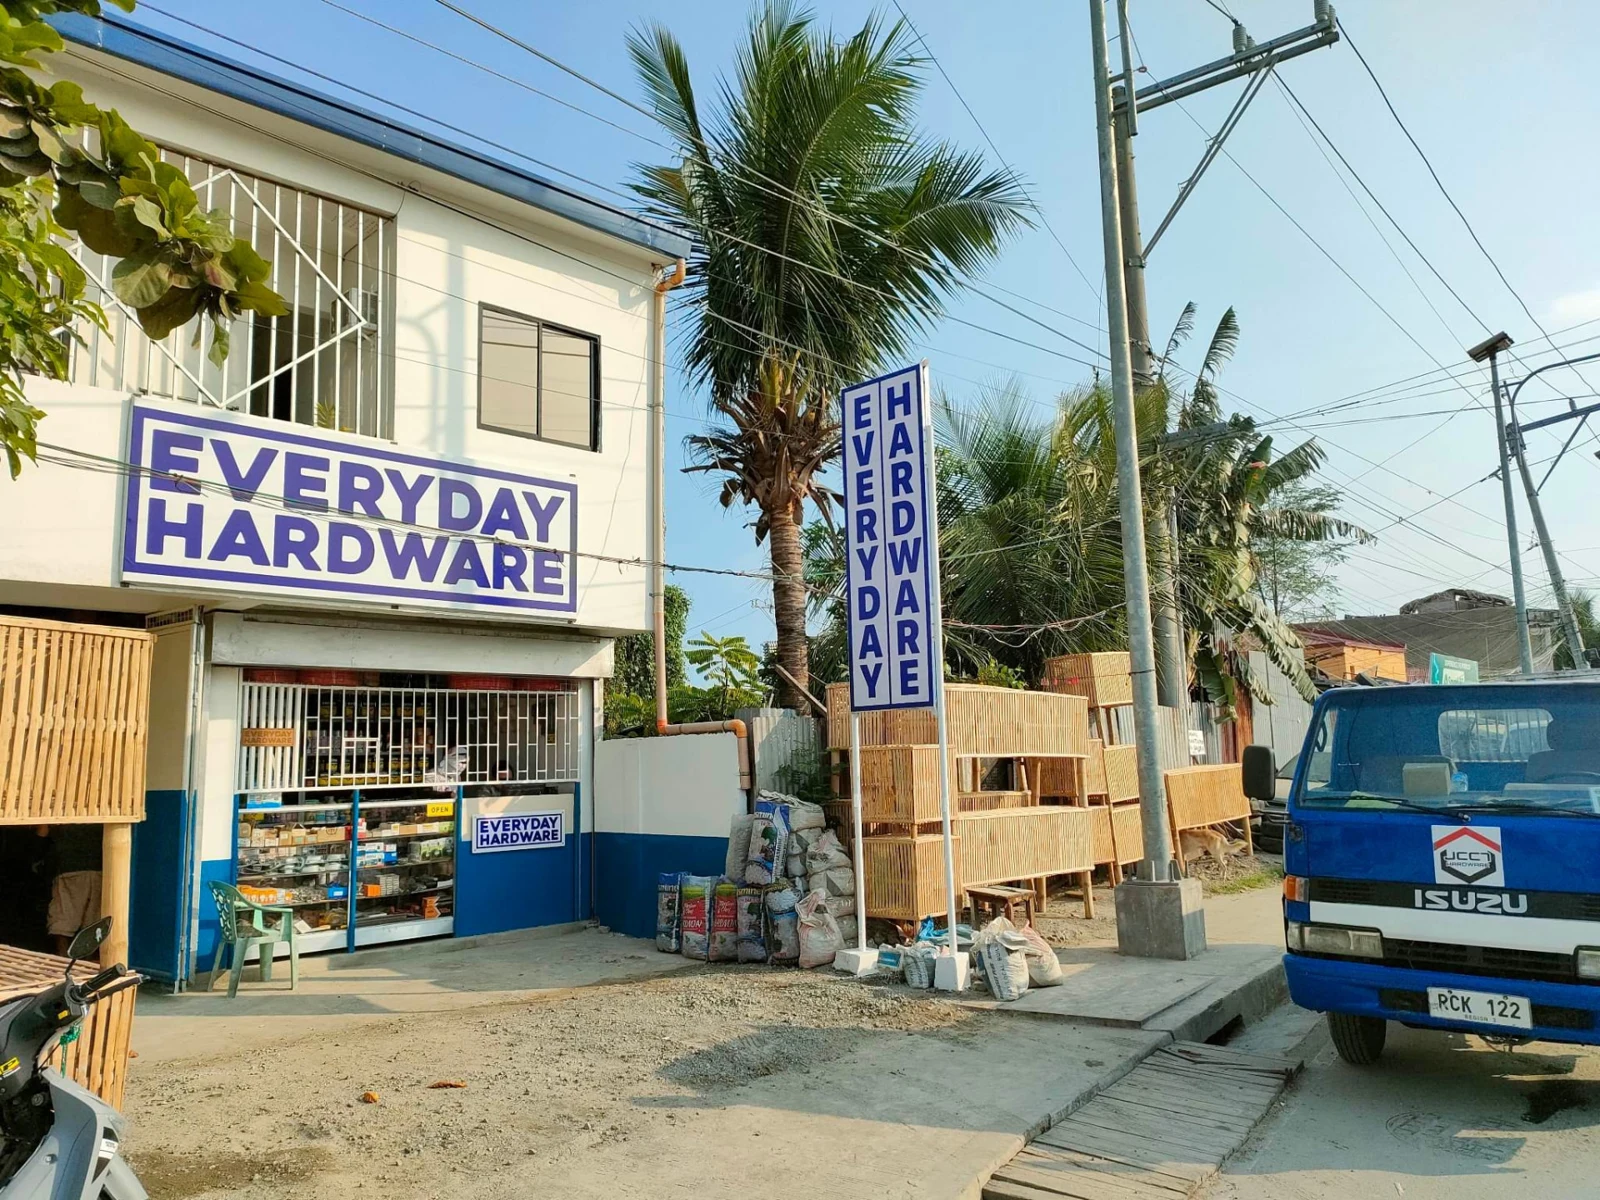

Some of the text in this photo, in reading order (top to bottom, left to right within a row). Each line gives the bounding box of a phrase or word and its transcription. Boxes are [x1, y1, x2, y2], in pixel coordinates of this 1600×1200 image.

[149, 429, 564, 543] EVERYDAY
[146, 498, 564, 596] HARDWARE
[852, 394, 883, 698] EVERYDAY
[887, 381, 921, 696] HARDWARE
[244, 730, 292, 738] EVERYDAY
[431, 806, 449, 814] OPEN
[480, 816, 558, 833] EVERYDAY
[480, 829, 559, 846] HARDWARE
[1414, 889, 1528, 914] ISUZU
[1438, 993, 1521, 1019] RCK 122
